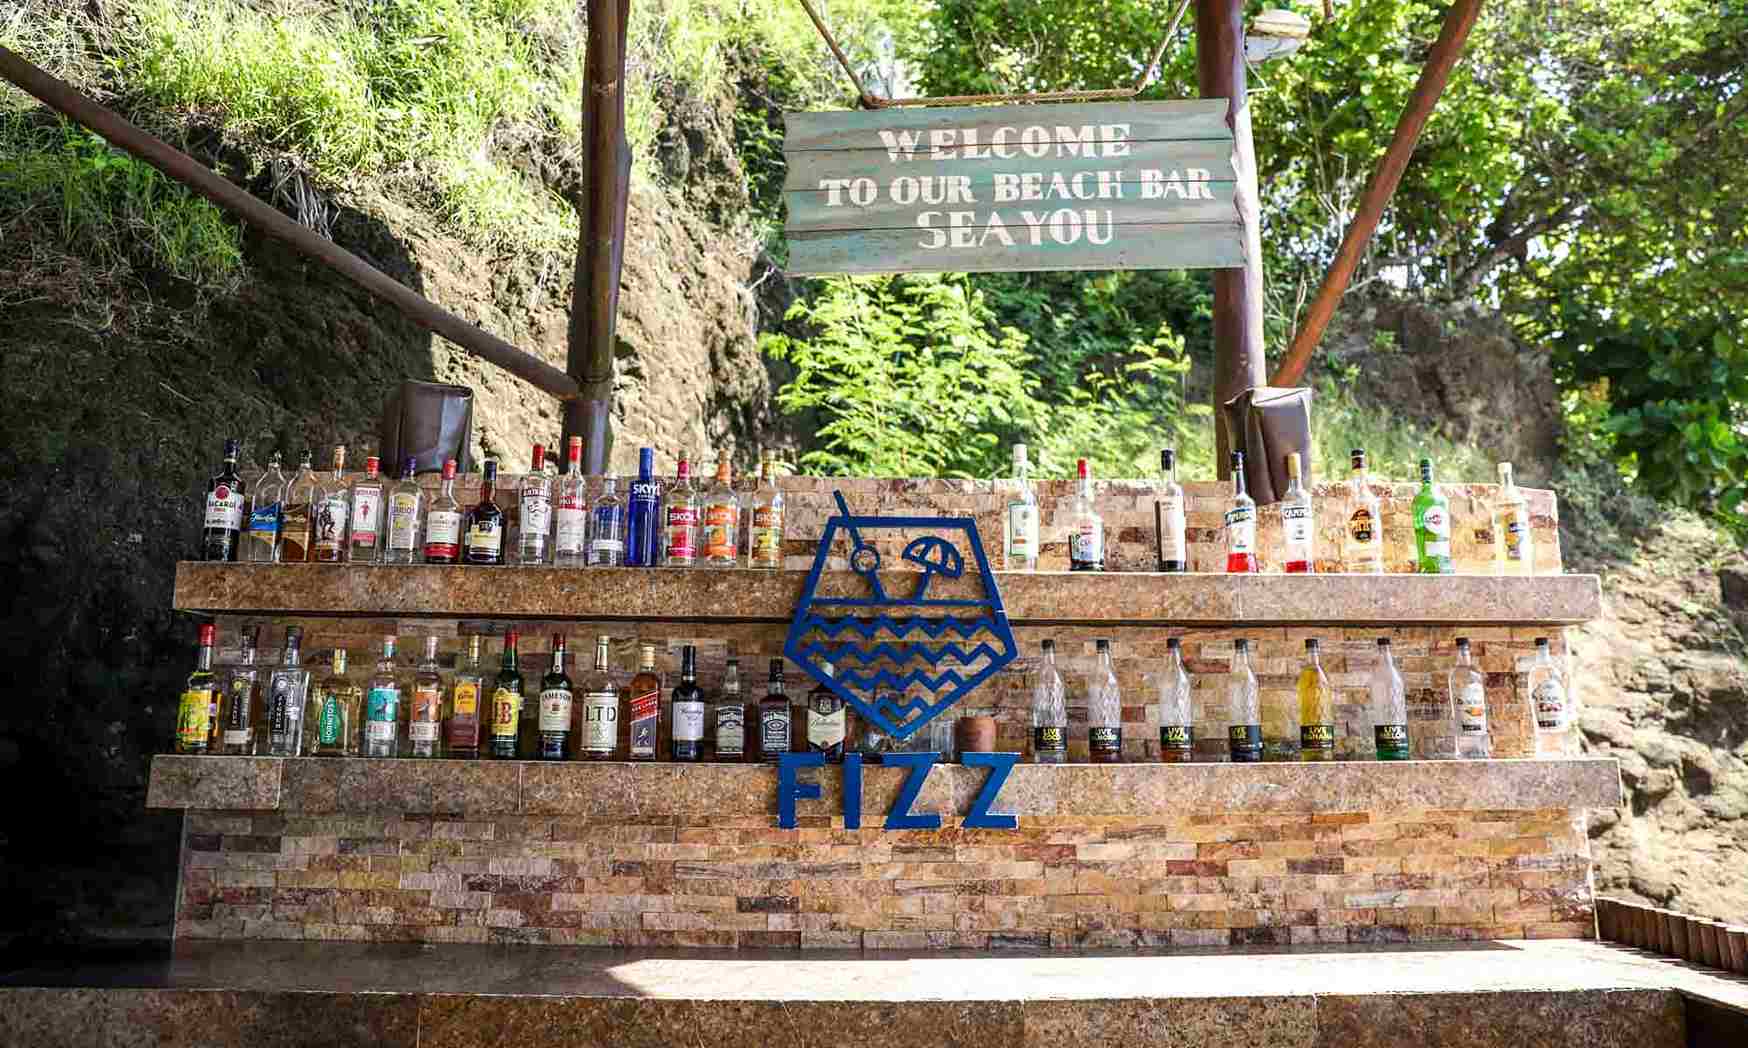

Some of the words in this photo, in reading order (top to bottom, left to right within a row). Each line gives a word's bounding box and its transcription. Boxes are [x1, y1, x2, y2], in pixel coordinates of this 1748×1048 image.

[877, 122, 1131, 163] WELCOME
[819, 177, 877, 207] TO
[889, 175, 974, 205] OUR
[992, 170, 1121, 203] BEACH
[1140, 167, 1215, 200] BAR
[917, 210, 1015, 249] SEA
[1016, 208, 1113, 246] YOU
[669, 511, 697, 521] SKOL
[586, 705, 616, 722] LTD
[1042, 728, 1060, 736] LIVE
[1167, 727, 1185, 736] LIVE
[778, 752, 1021, 831] FIZZ
